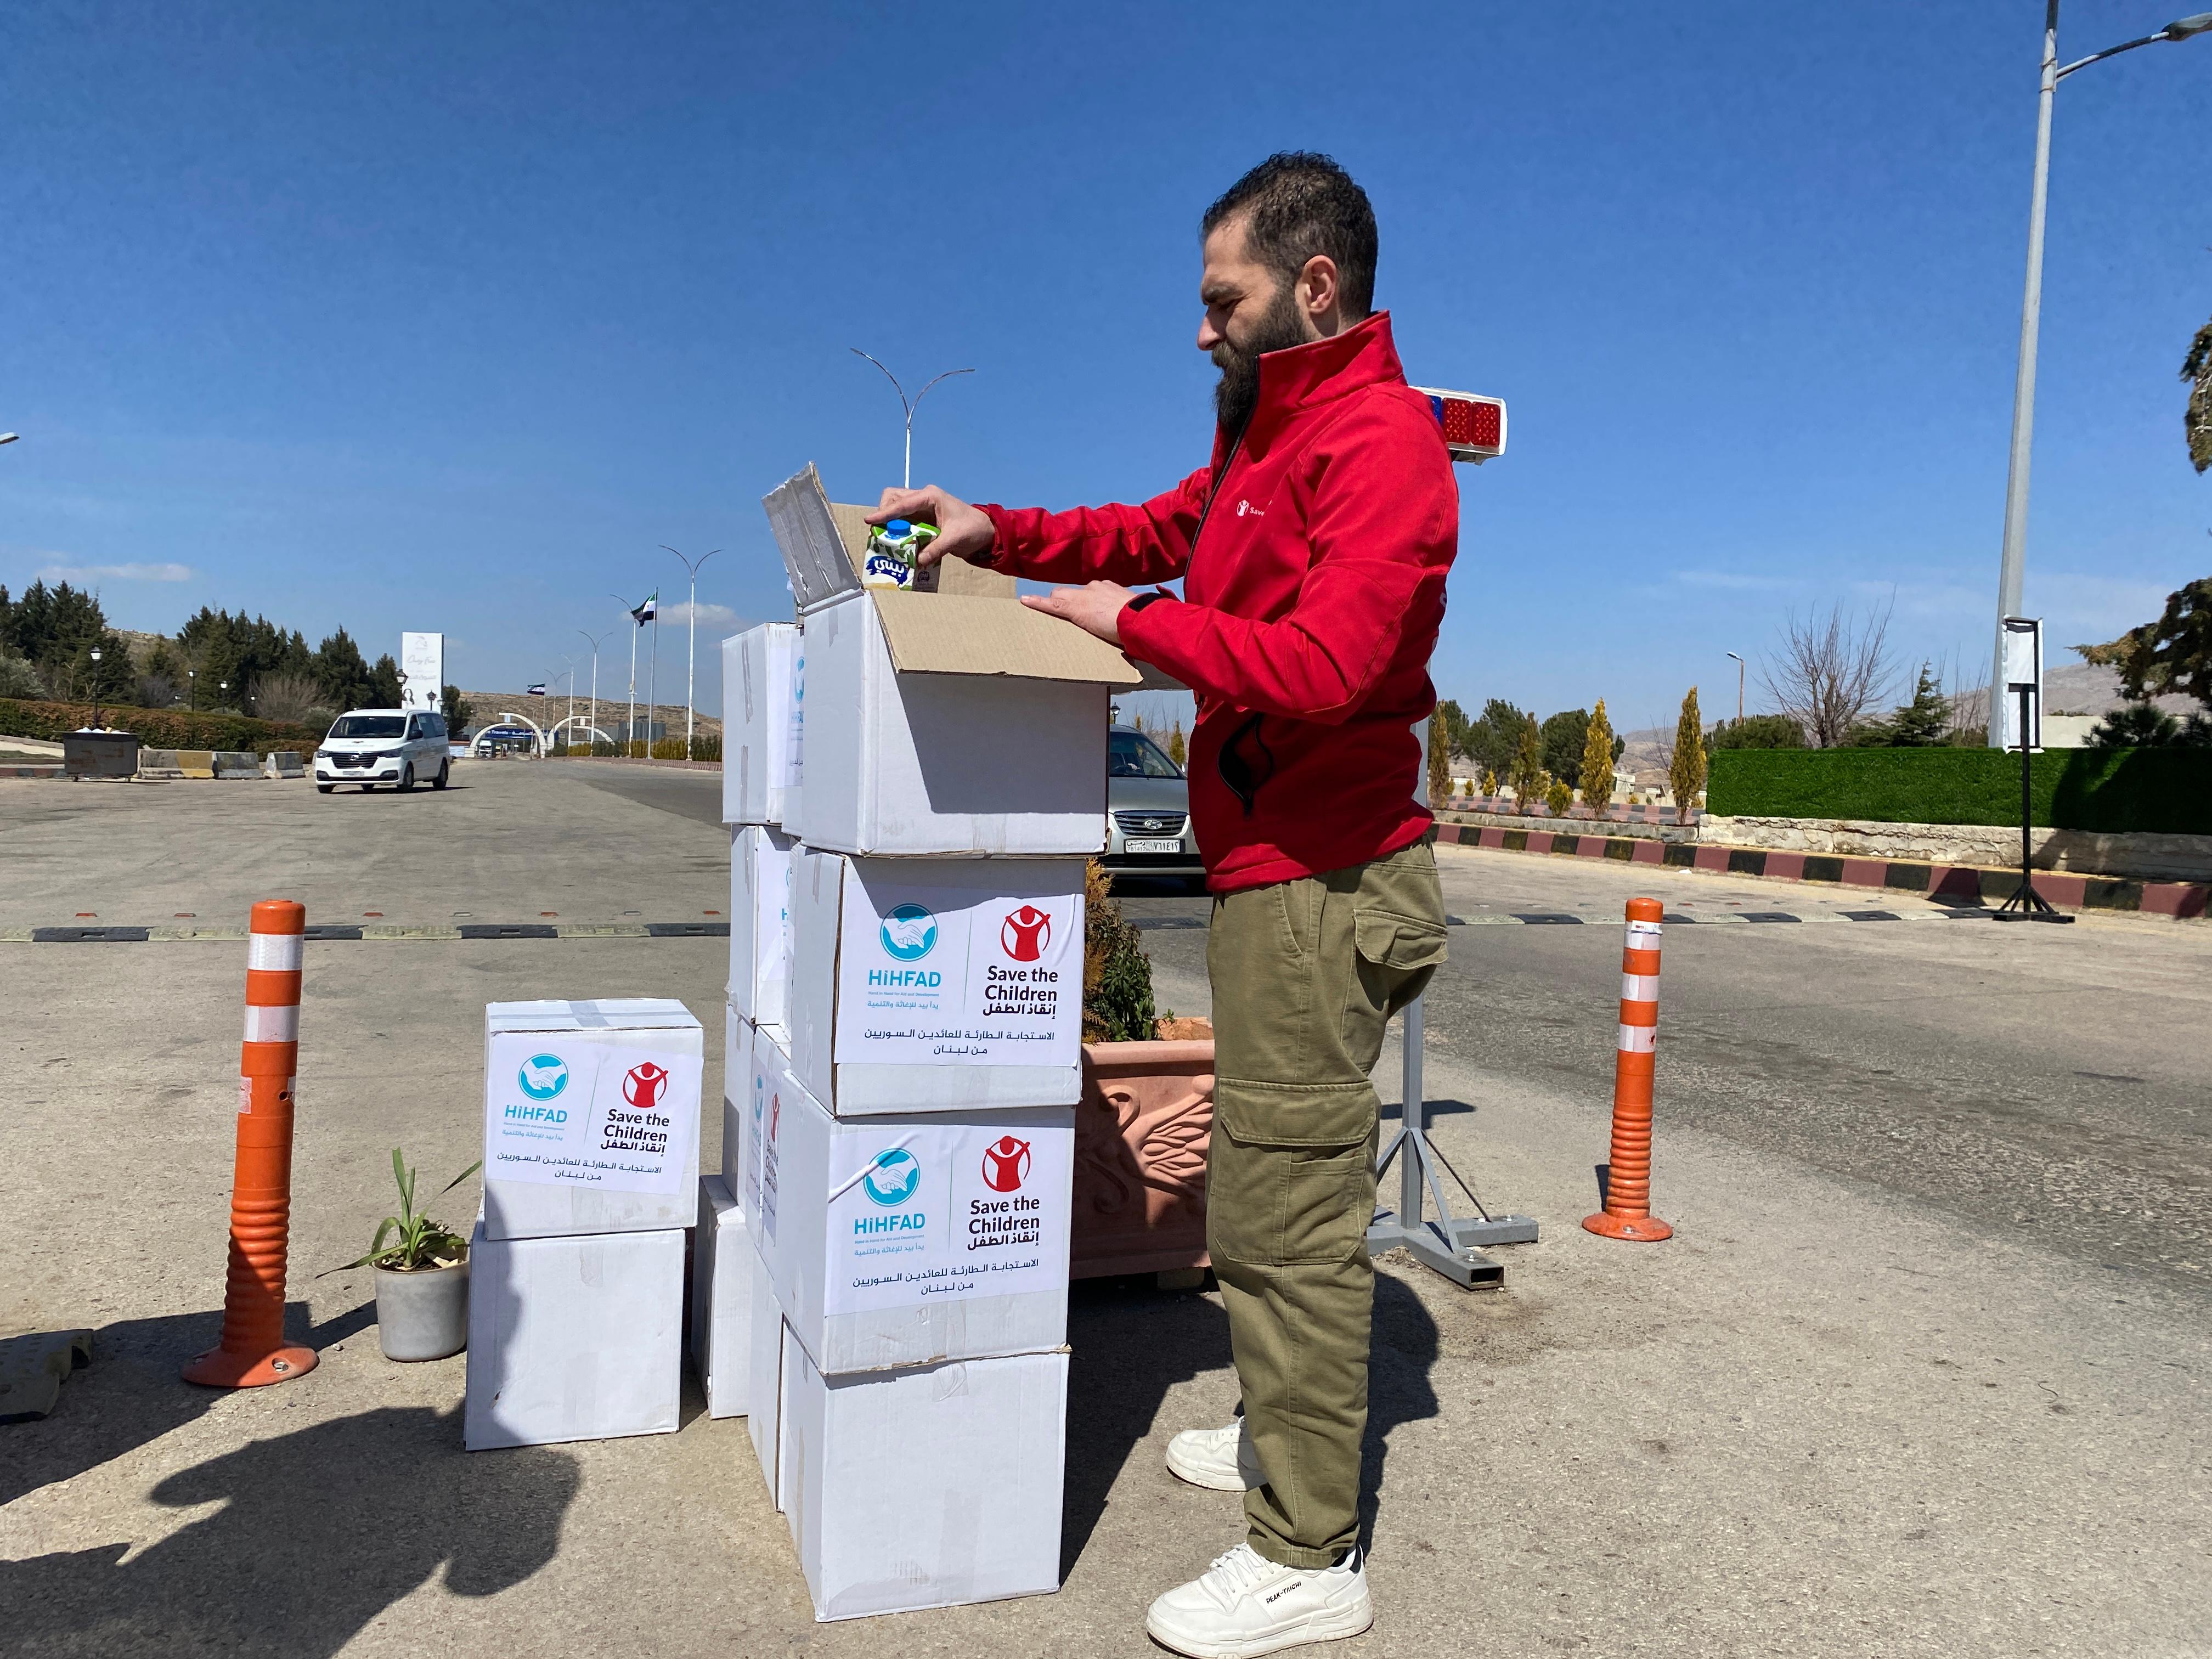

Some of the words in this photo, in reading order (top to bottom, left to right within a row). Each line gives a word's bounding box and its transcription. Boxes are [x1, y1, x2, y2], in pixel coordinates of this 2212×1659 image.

[868, 969, 941, 987] HiHFAD
[988, 966, 1027, 981] Save
[1031, 967, 1058, 983] the
[985, 985, 1057, 1002] Children
[983, 1002, 1025, 1016] الطفل
[1026, 1003, 1056, 1019] إنقاذ
[865, 1029, 915, 1039] السوريين
[918, 1029, 962, 1040] للعائدين
[964, 1030, 1003, 1041] الطارئة
[1006, 1031, 1054, 1042] الاستجابة
[933, 1045, 968, 1056] لبنان
[971, 1046, 988, 1056] من
[505, 1104, 567, 1123] HiHFAD
[607, 1109, 642, 1124] Save
[646, 1113, 670, 1127] the
[604, 1124, 667, 1142] Children
[601, 1139, 638, 1151] الطفل
[639, 1142, 665, 1157] إنقاذ
[497, 1152, 541, 1162] السوريين
[543, 1156, 580, 1166] للعائدين
[583, 1160, 617, 1169] الطارئة
[619, 1163, 662, 1173] الاستجابة
[555, 1170, 585, 1180] لبنان
[970, 1199, 1009, 1215] Save
[1013, 1195, 1040, 1211] the
[855, 1213, 926, 1234] HiHFAD
[969, 1216, 1040, 1234] Children
[967, 1234, 1009, 1251] الطفل
[1010, 1231, 1039, 1246] إنقاذ
[951, 1263, 988, 1276] الطارئة
[991, 1259, 1039, 1272] الاستجابة
[853, 1273, 902, 1288] السوريين
[905, 1268, 947, 1282] للعائدين
[921, 1282, 955, 1295] لبنان
[958, 1282, 974, 1291] من
[1266, 1581, 1301, 1604] PEAK-TAICHI
